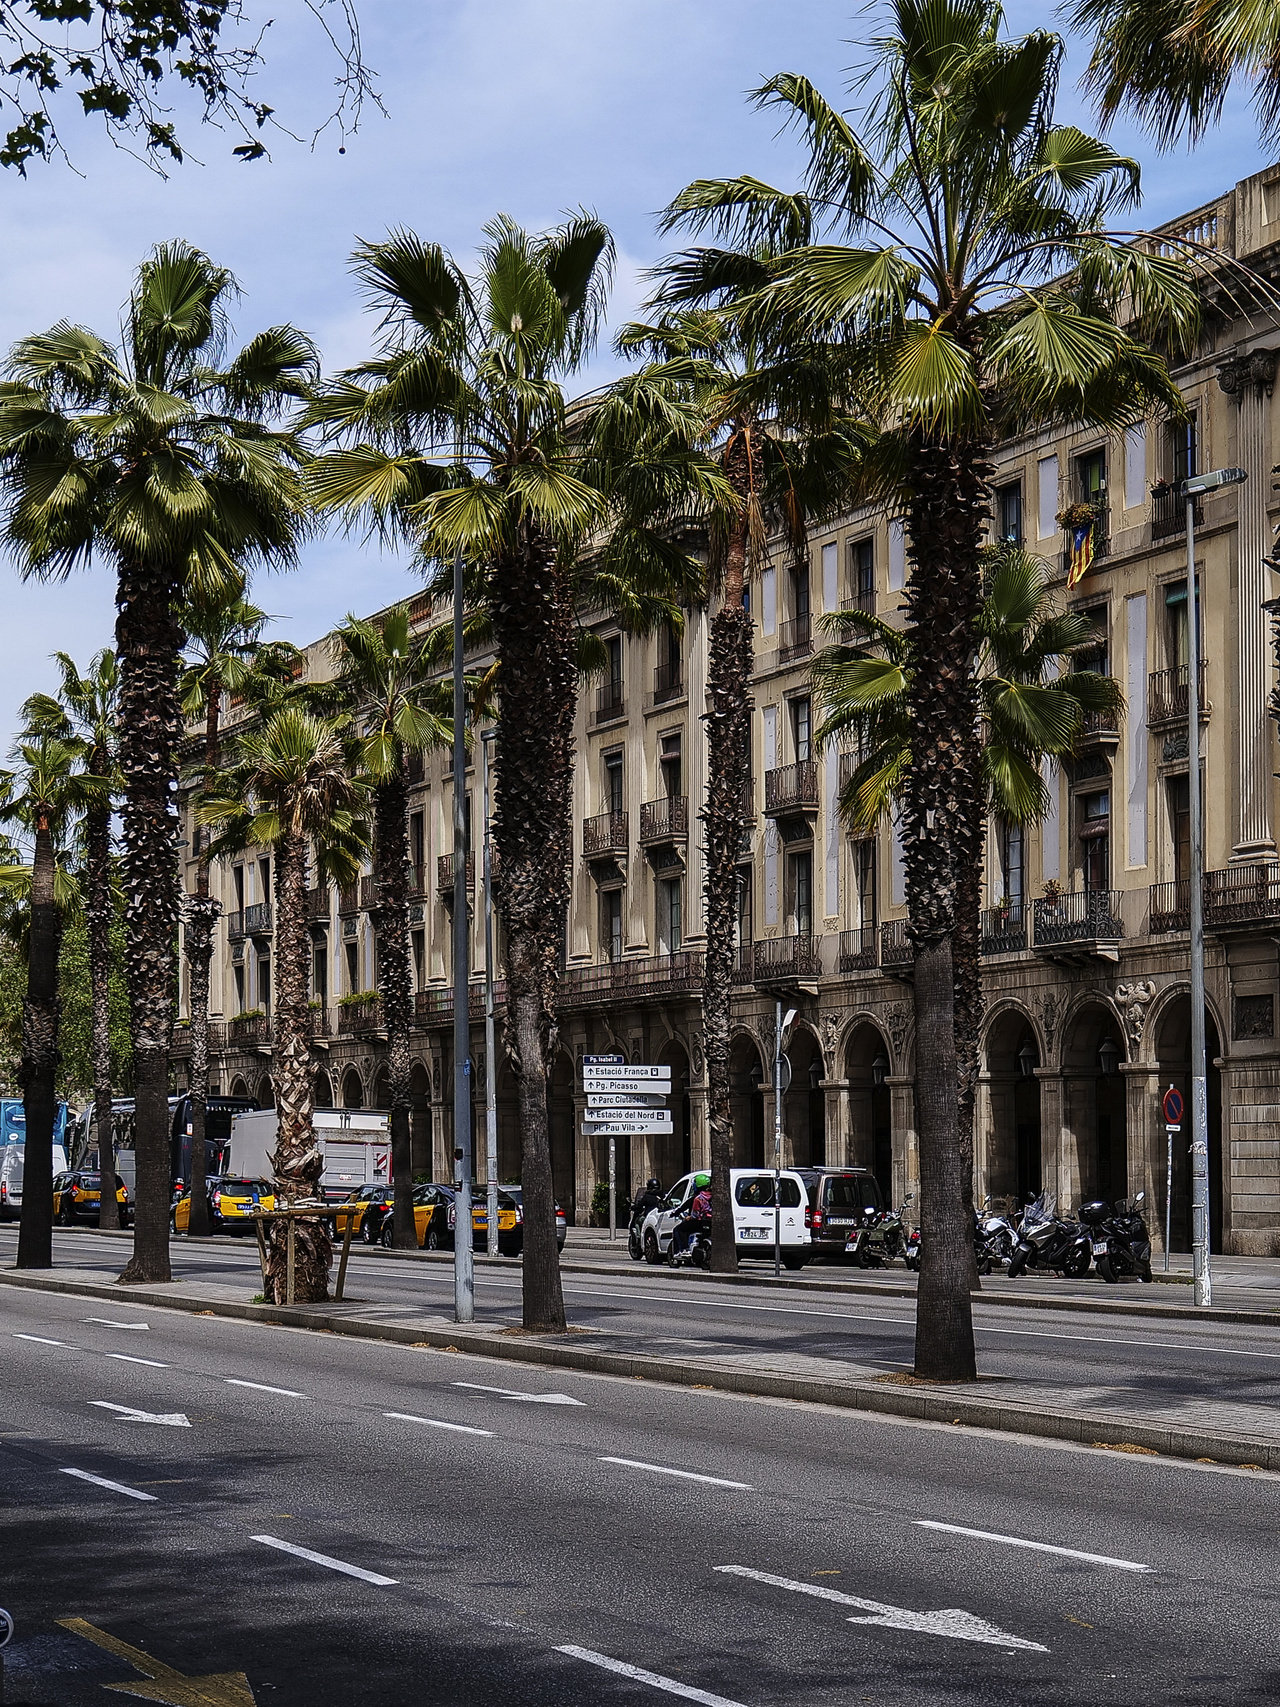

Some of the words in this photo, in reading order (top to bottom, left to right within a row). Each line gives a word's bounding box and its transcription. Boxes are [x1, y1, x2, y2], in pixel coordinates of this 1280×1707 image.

[595, 1067, 622, 1075] Estació
[624, 1067, 649, 1076] França
[595, 1081, 608, 1091] Pg.
[609, 1081, 639, 1090] Picasso
[598, 1096, 614, 1104] Parc
[615, 1096, 648, 1104] Ciutadella
[596, 1110, 623, 1119] Estació
[624, 1111, 636, 1119] del
[637, 1111, 655, 1119] Nord
[593, 1124, 604, 1132] Pl.
[605, 1124, 620, 1132] Pau
[621, 1123, 636, 1132] Vila
